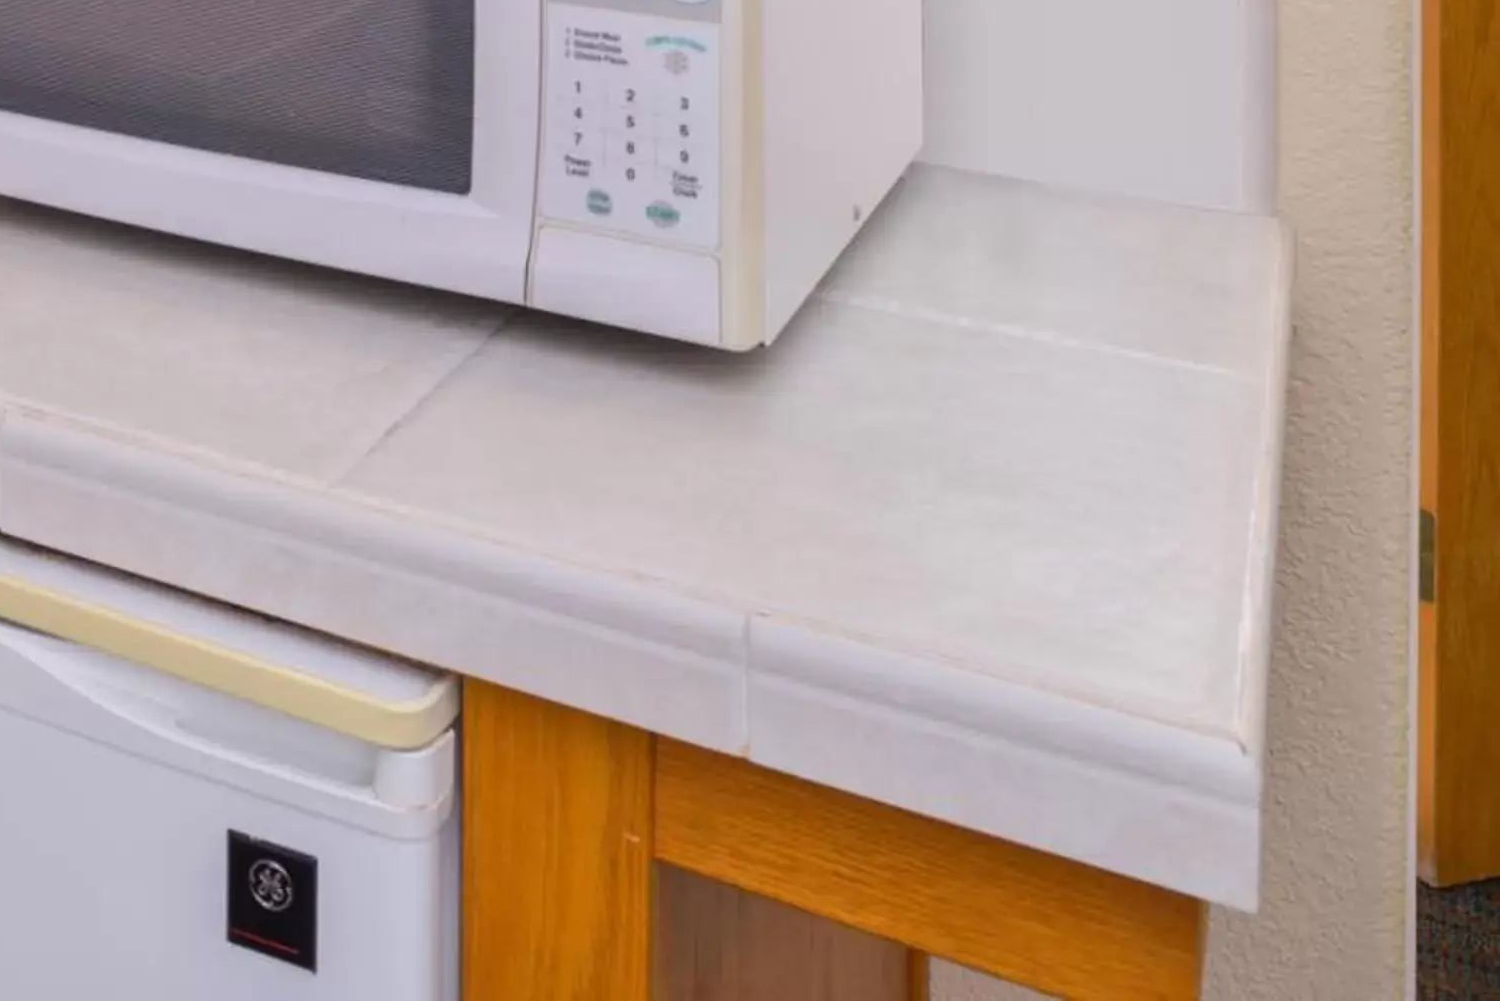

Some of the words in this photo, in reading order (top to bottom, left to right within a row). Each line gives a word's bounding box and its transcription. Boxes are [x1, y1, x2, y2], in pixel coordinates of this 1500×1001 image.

[574, 80, 581, 93] 1
[626, 88, 636, 102] 2
[574, 106, 583, 119] 4
[626, 115, 635, 128] 5
[574, 132, 583, 146] 7
